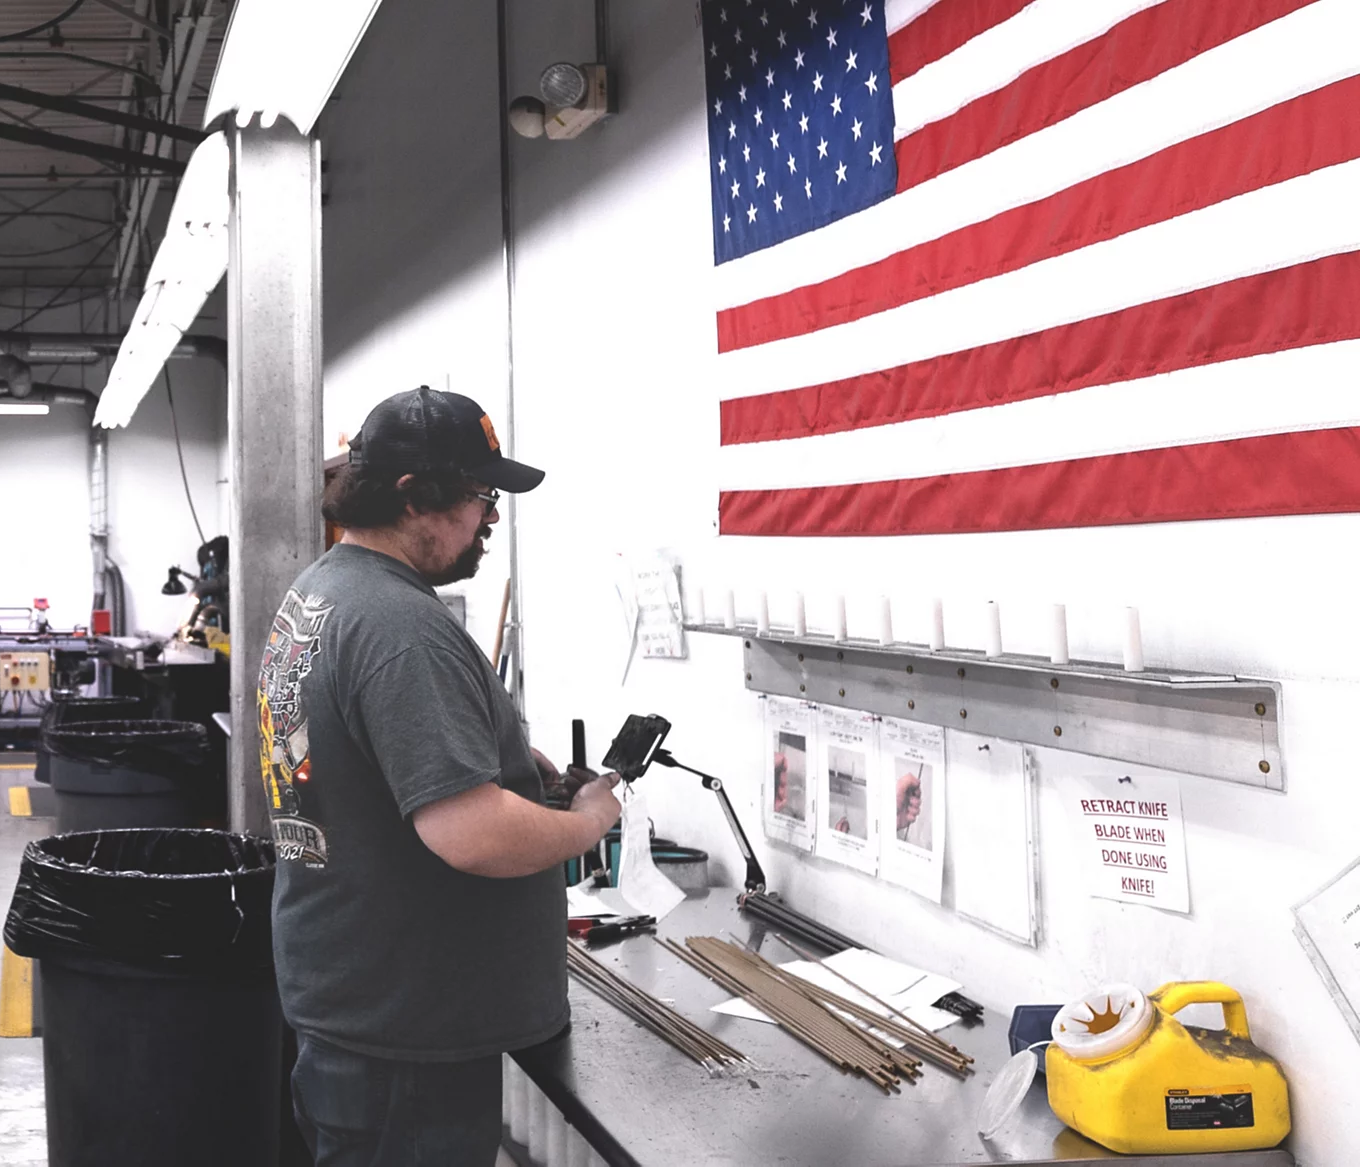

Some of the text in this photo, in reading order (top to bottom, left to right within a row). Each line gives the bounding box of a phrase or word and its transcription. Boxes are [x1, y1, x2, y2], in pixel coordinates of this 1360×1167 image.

[1080, 799, 1168, 817] RETRACT KNIFE
[1094, 824, 1166, 843] BLADE WHEN
[1101, 849, 1168, 870] DONE USING
[1121, 876, 1155, 894] KNIFE!
[1184, 1097, 1206, 1105] Disposal
